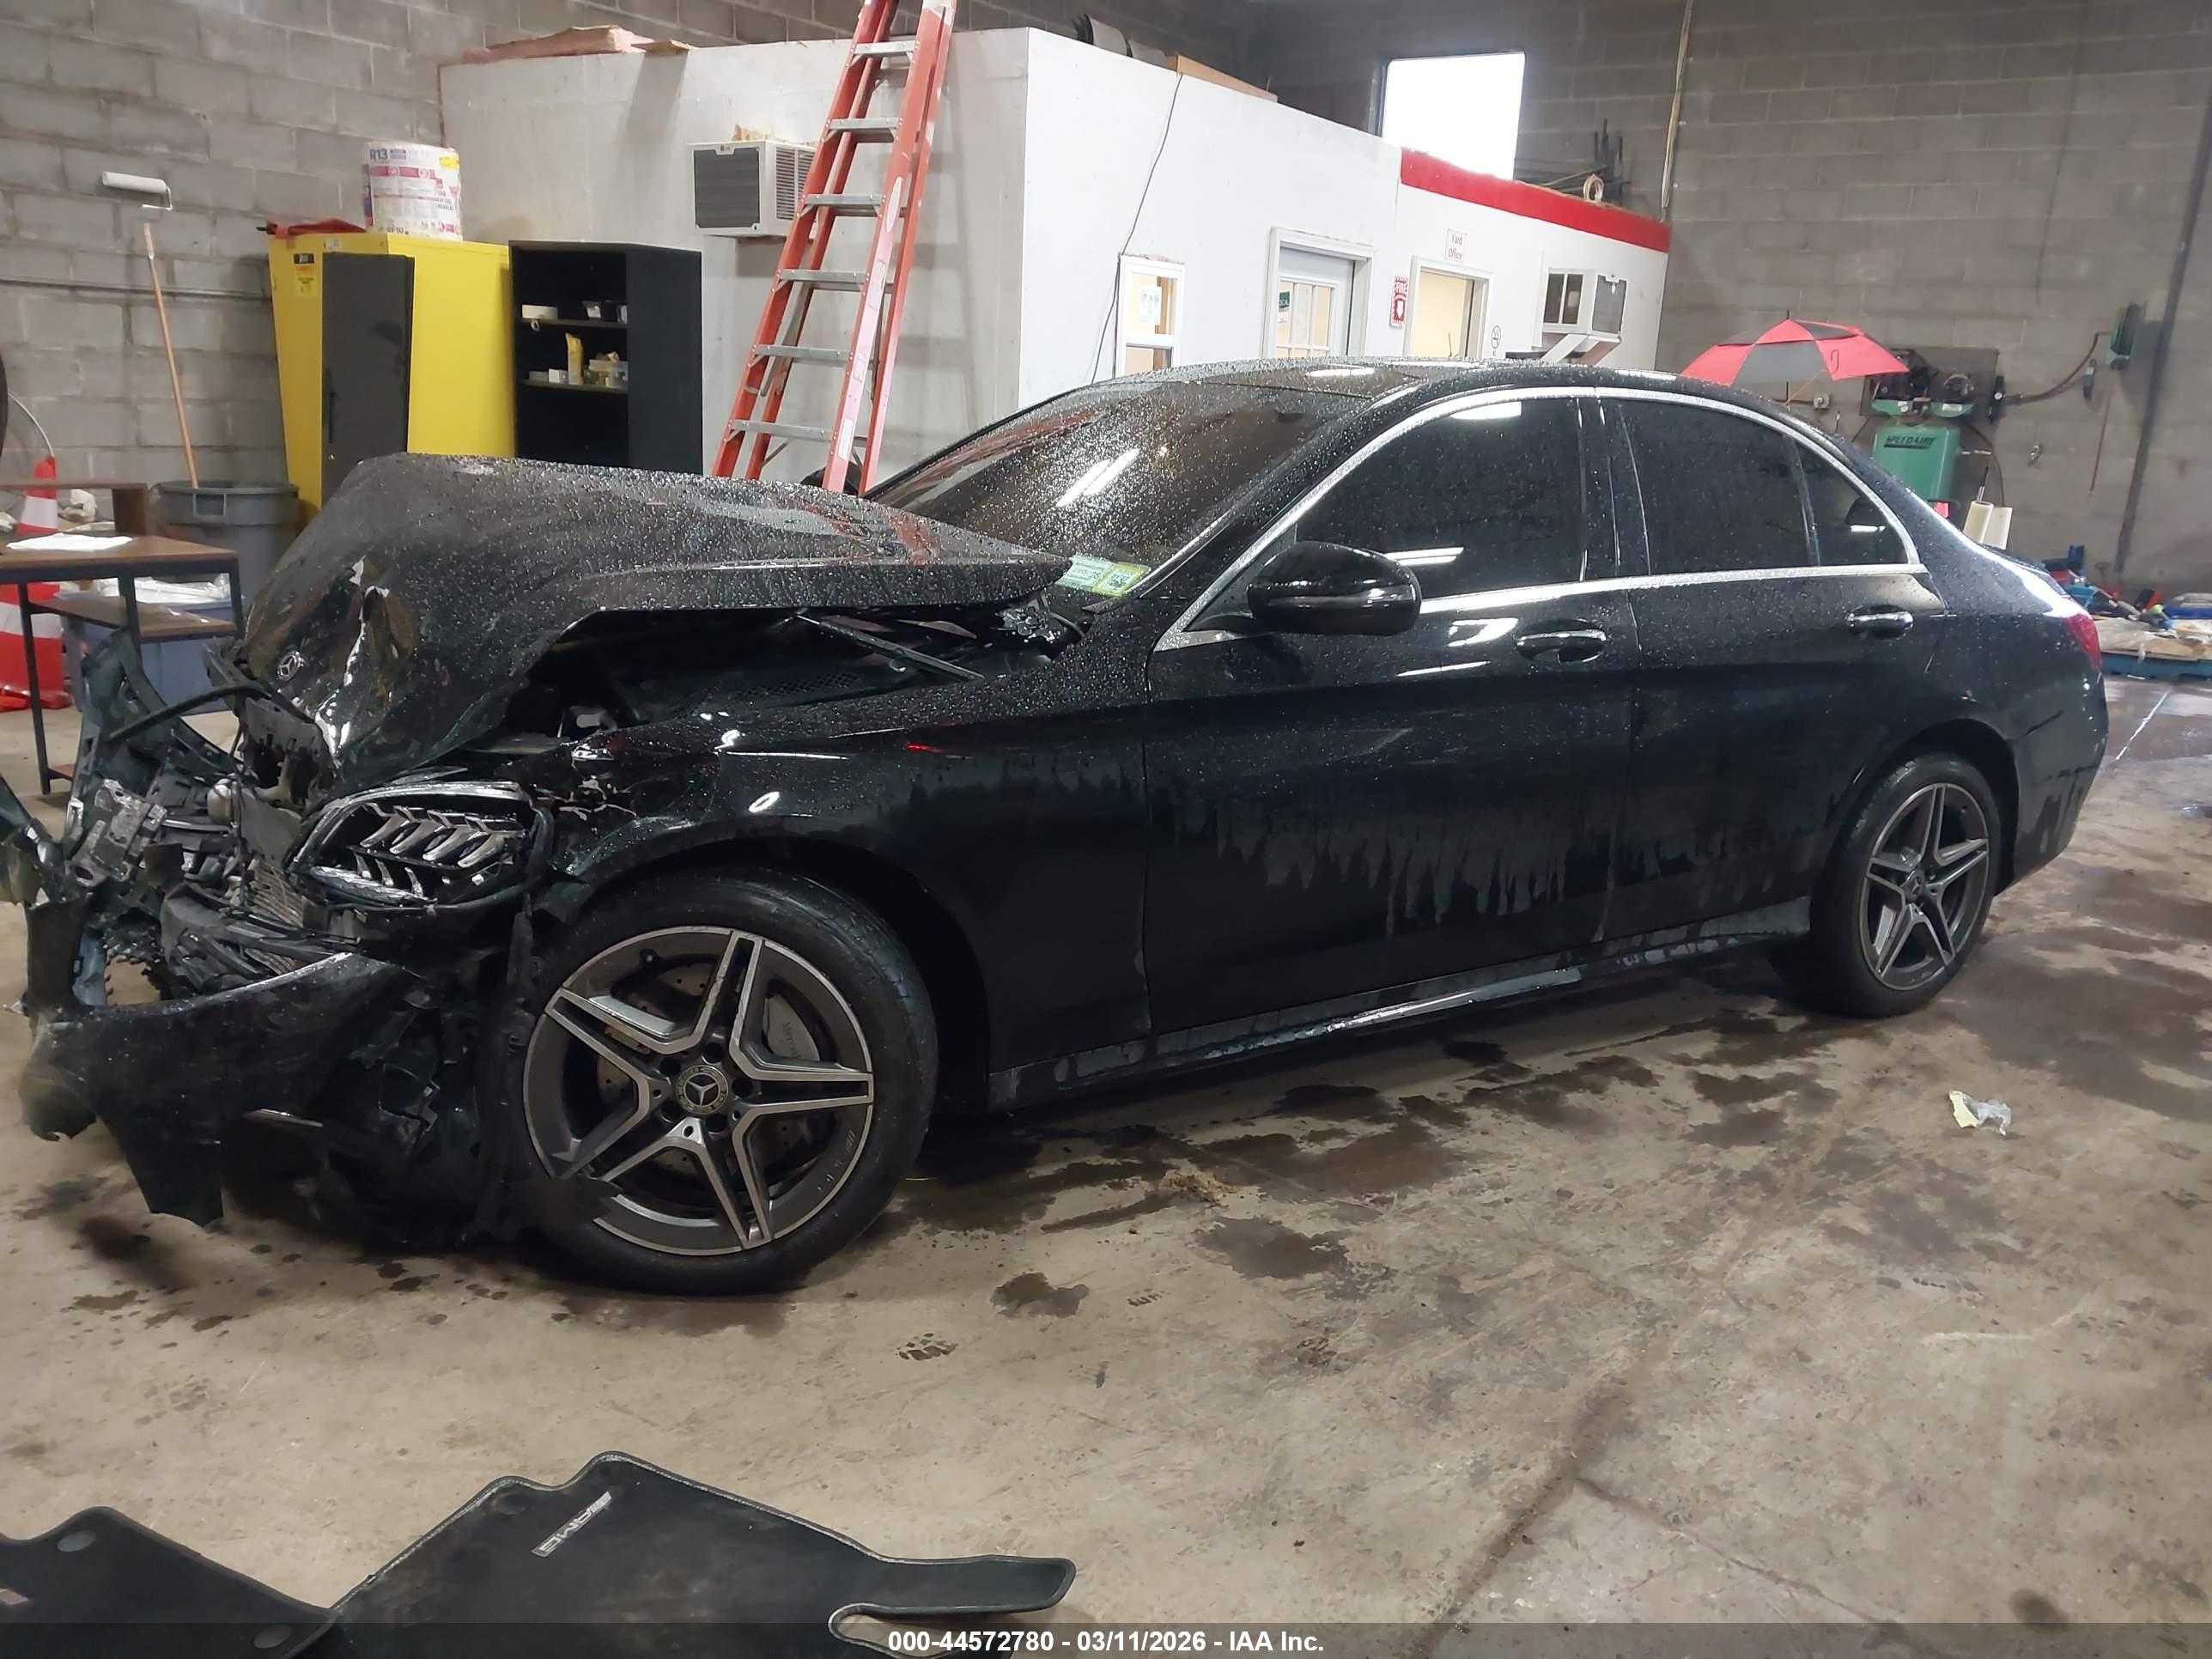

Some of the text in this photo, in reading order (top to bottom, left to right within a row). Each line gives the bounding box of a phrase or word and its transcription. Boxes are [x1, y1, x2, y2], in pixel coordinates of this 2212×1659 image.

[1451, 233, 1463, 246] Yard
[1448, 247, 1463, 261] Office
[1395, 282, 1407, 295] FIRE
